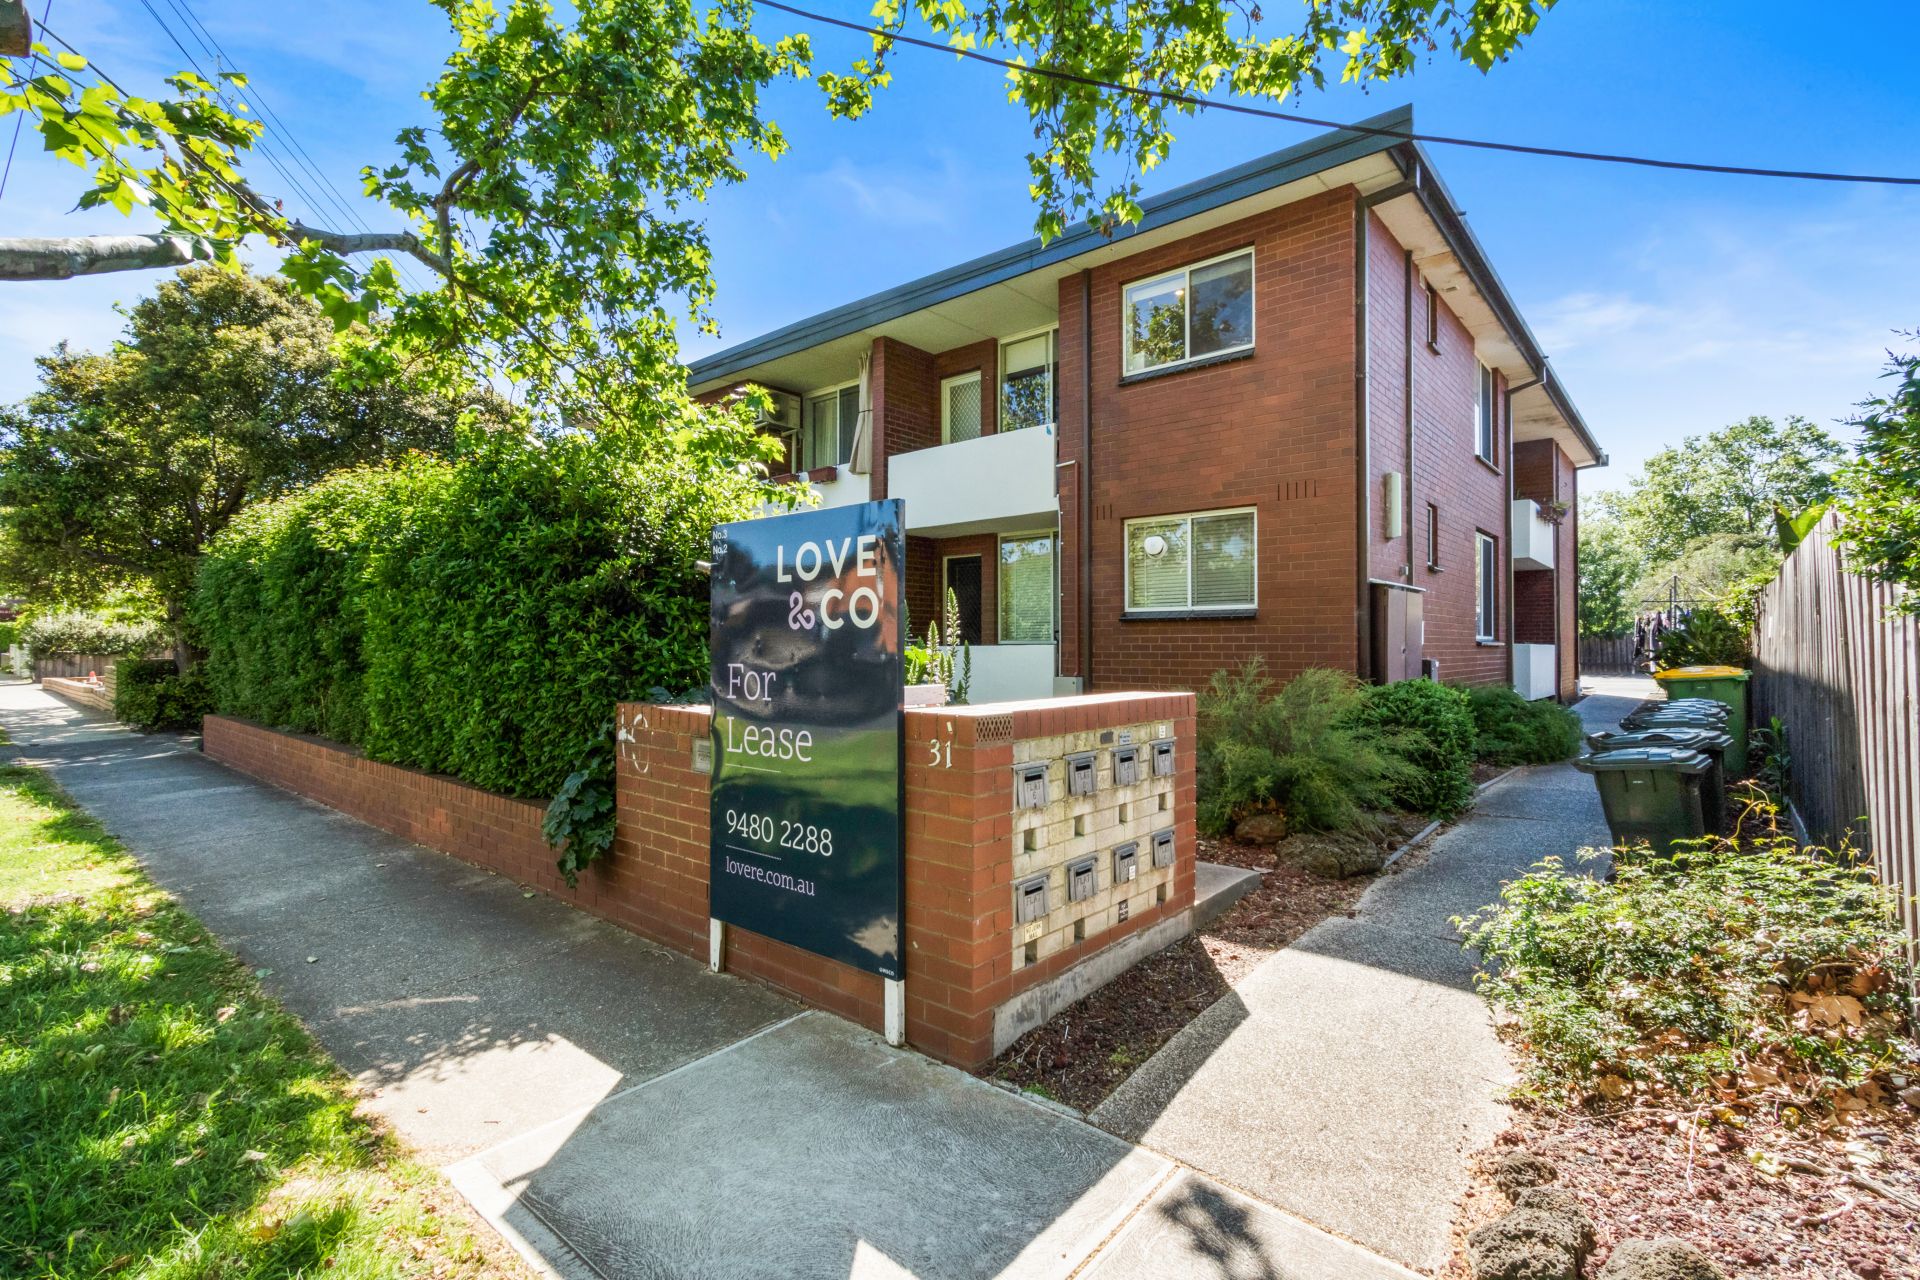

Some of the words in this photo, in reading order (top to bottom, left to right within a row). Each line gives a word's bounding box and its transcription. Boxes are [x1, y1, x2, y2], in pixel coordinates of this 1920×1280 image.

[712, 529, 728, 540] No.3
[777, 534, 876, 583] LOVE
[726, 663, 776, 701] For
[726, 716, 812, 762] Lease
[927, 738, 953, 769] 31
[726, 809, 774, 843] 9480
[780, 820, 833, 857] 2288
[725, 855, 815, 896] lovere.com.au
